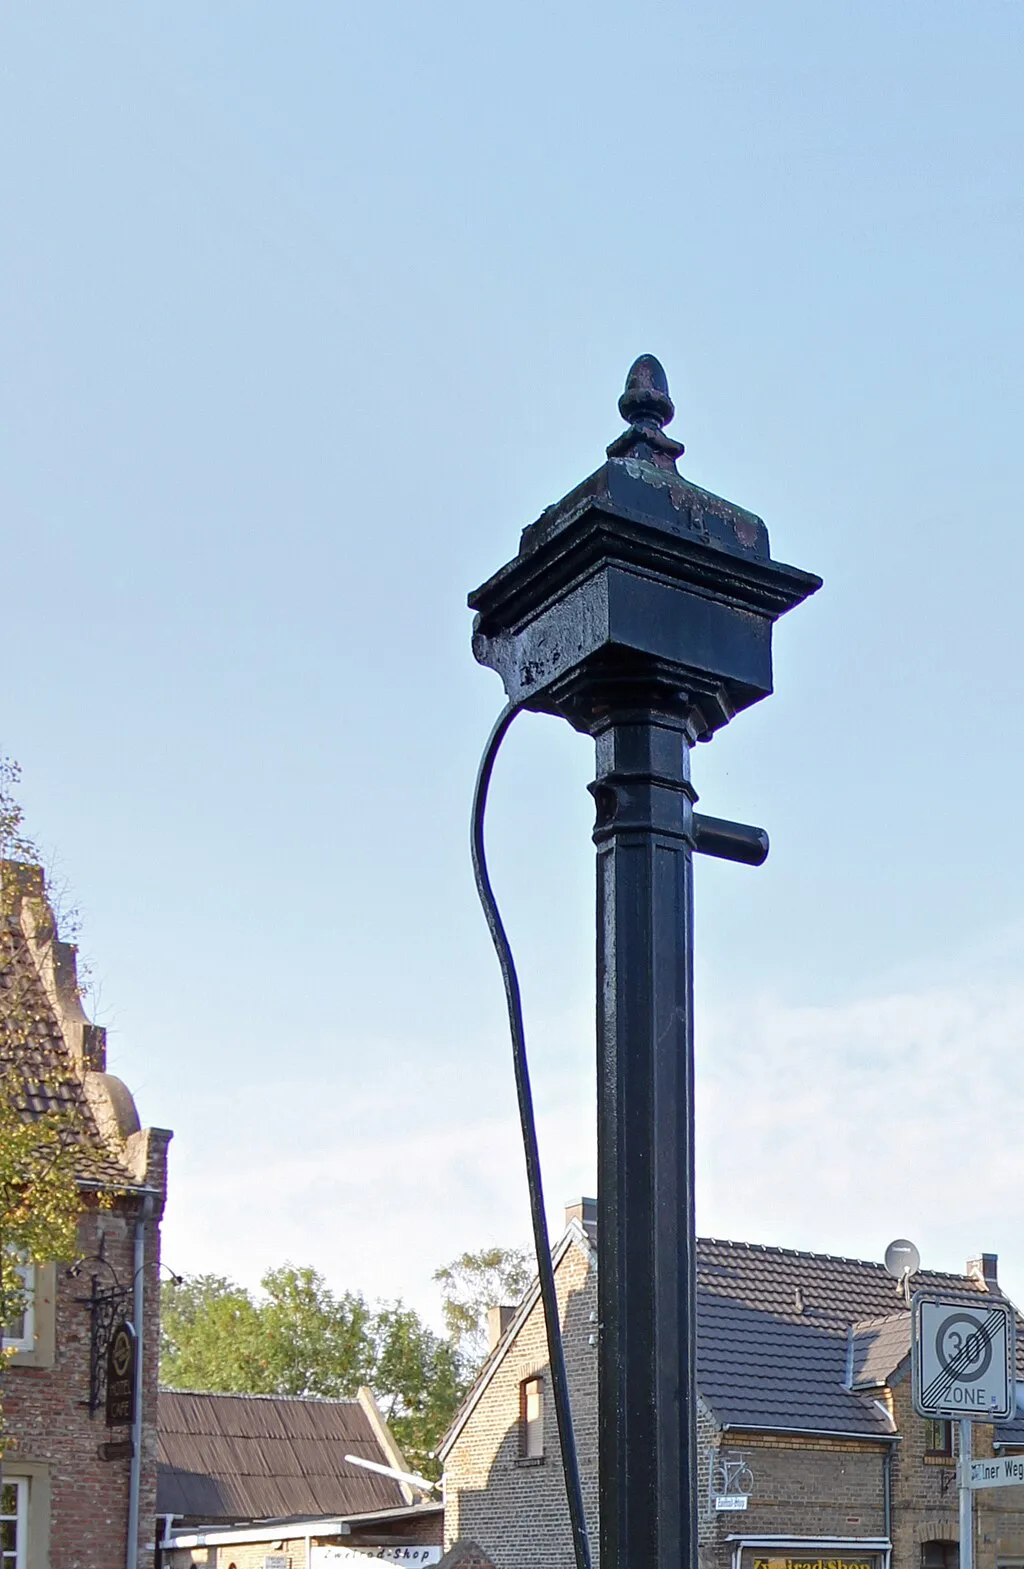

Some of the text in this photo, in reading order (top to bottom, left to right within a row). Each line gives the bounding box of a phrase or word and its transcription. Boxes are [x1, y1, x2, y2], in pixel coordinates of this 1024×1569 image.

[947, 1331, 980, 1364] 30
[943, 1386, 986, 1406] ZONE
[1004, 1459, 1024, 1481] Weg
[323, 1547, 431, 1564] Zweirad-Shop
